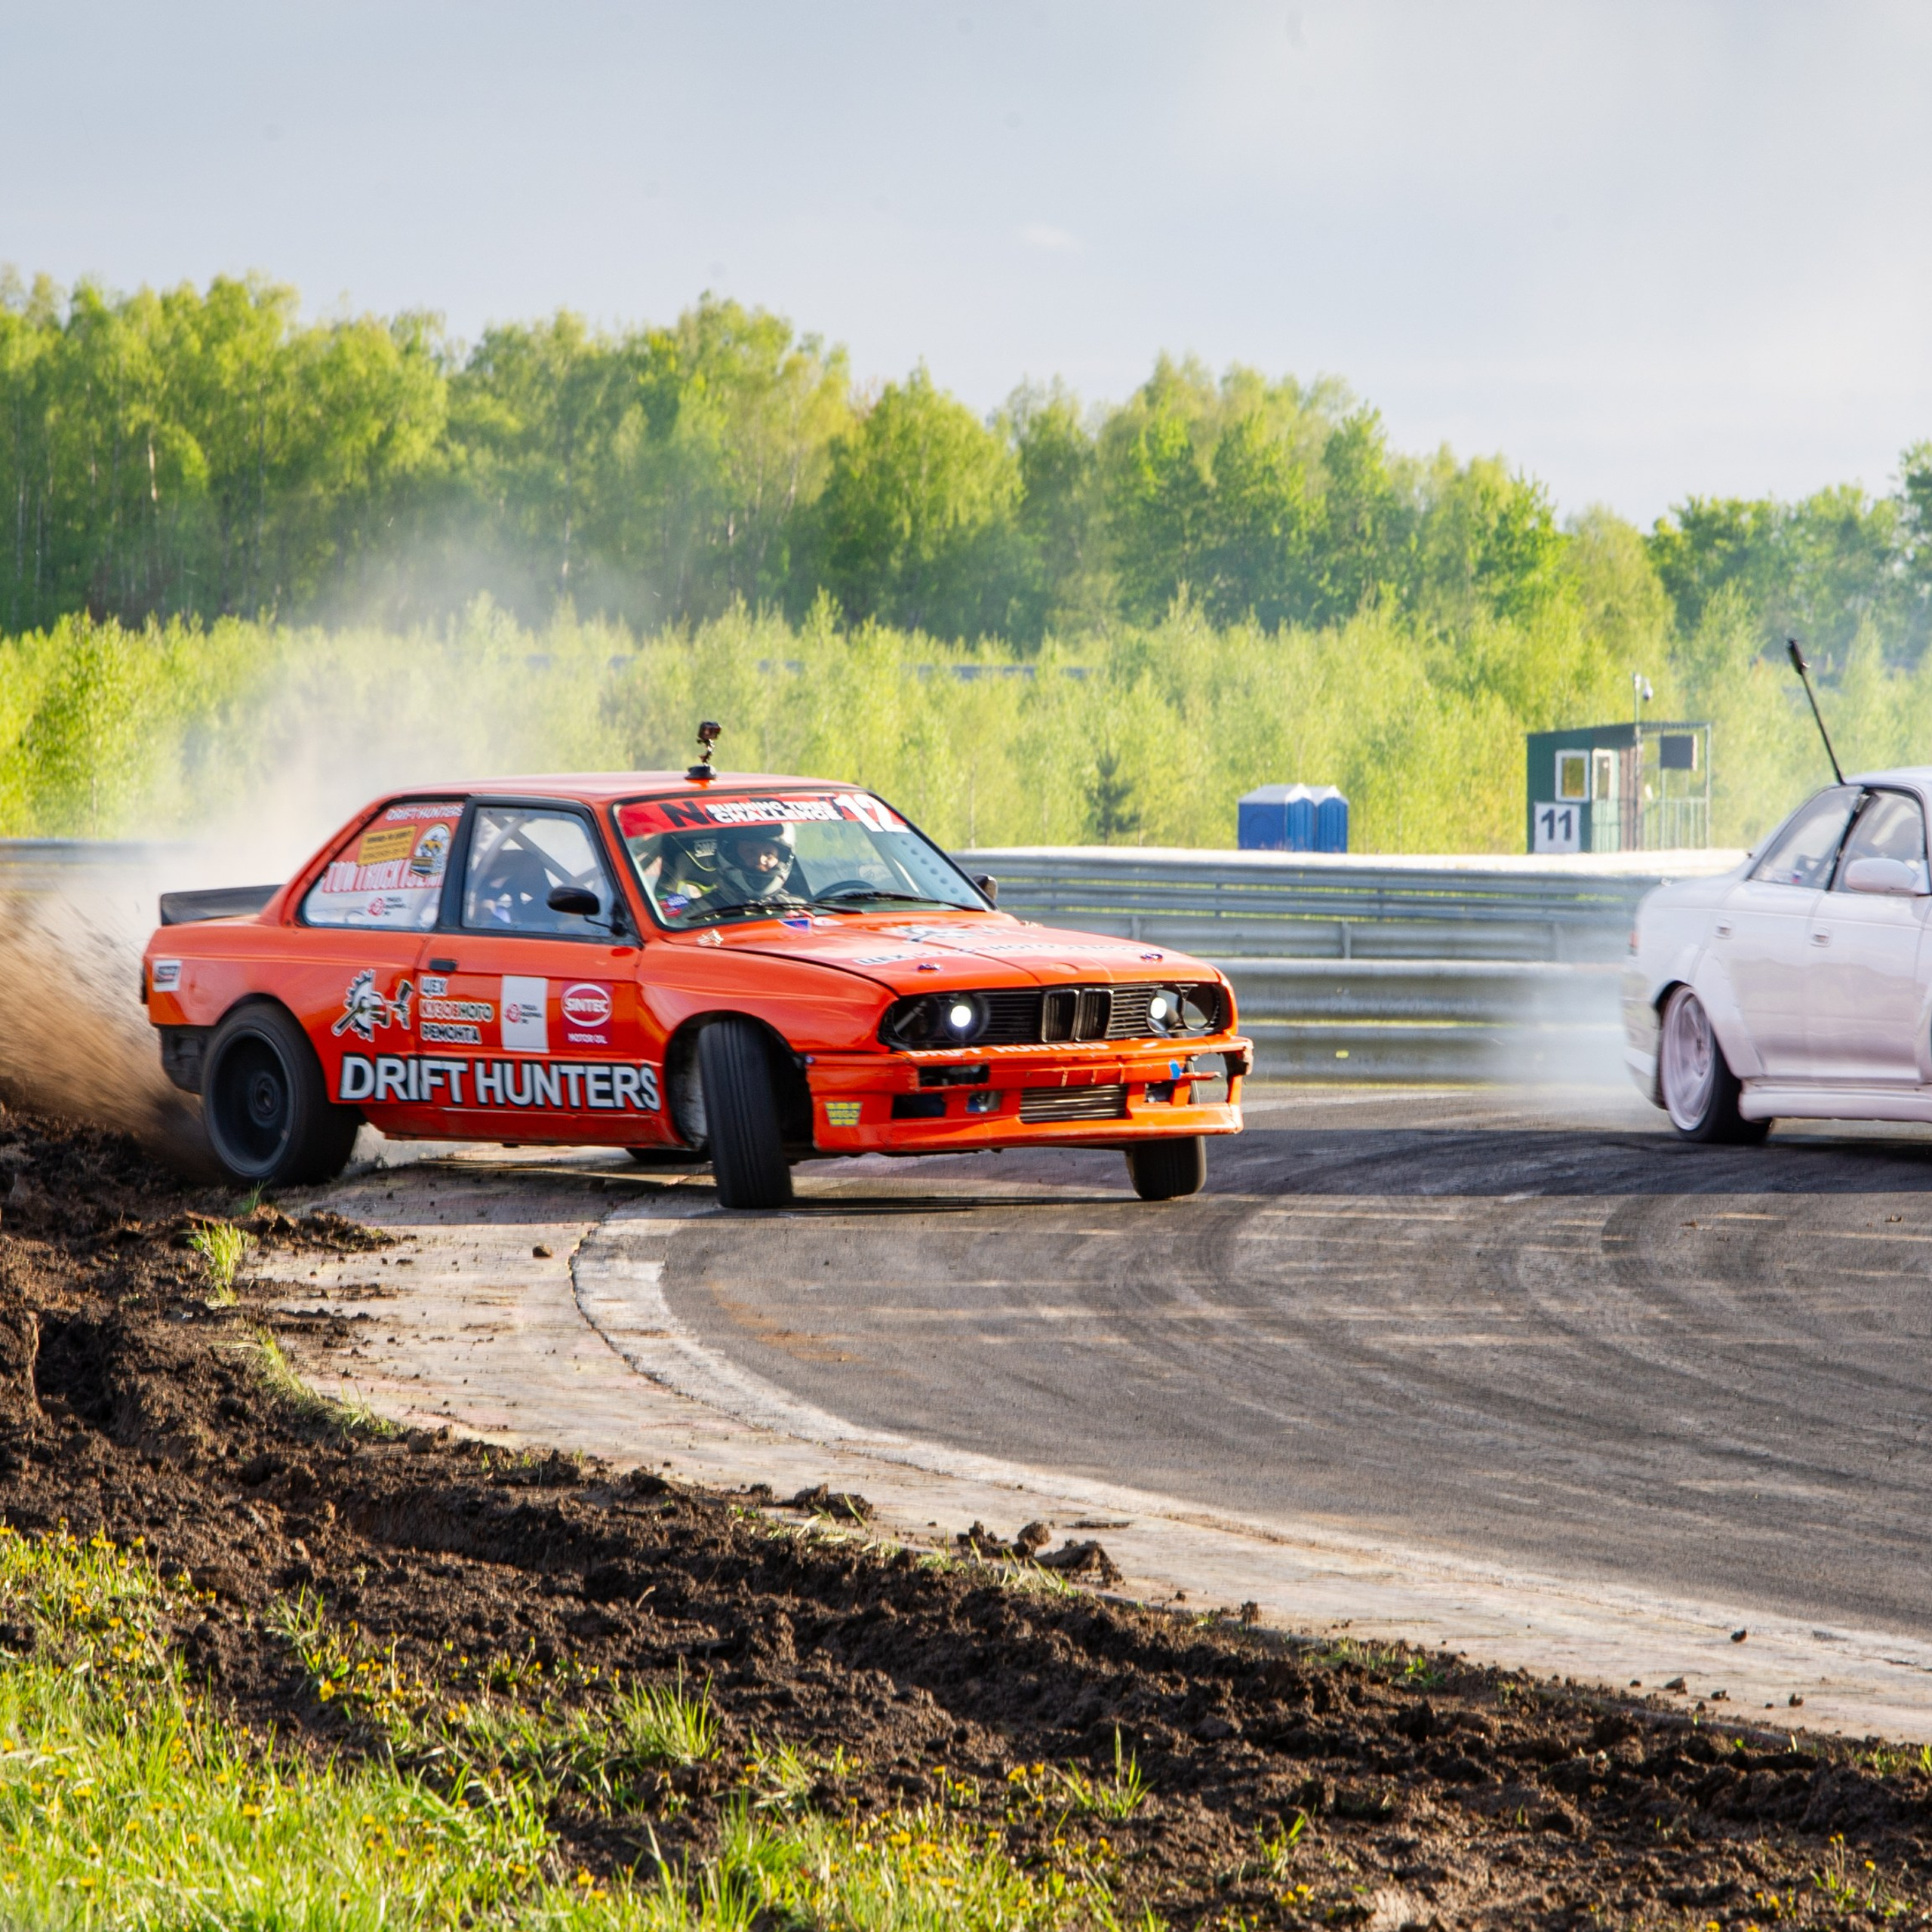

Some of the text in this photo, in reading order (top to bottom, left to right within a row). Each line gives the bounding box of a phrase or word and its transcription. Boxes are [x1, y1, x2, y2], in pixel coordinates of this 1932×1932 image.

[713, 810, 844, 824] CHALLENGE
[833, 793, 911, 833] 12
[1541, 808, 1572, 841] 11
[420, 977, 447, 997] ЦЕХ
[420, 1000, 494, 1022] КУЗОВНОГО
[565, 998, 610, 1013] SINTEC
[420, 1023, 482, 1044] РЕМОНТА
[568, 1033, 594, 1043] MOTOR
[907, 1043, 1110, 1057] DRIFT HUNTERS
[339, 1057, 661, 1112] DRIFT HUNTERS
